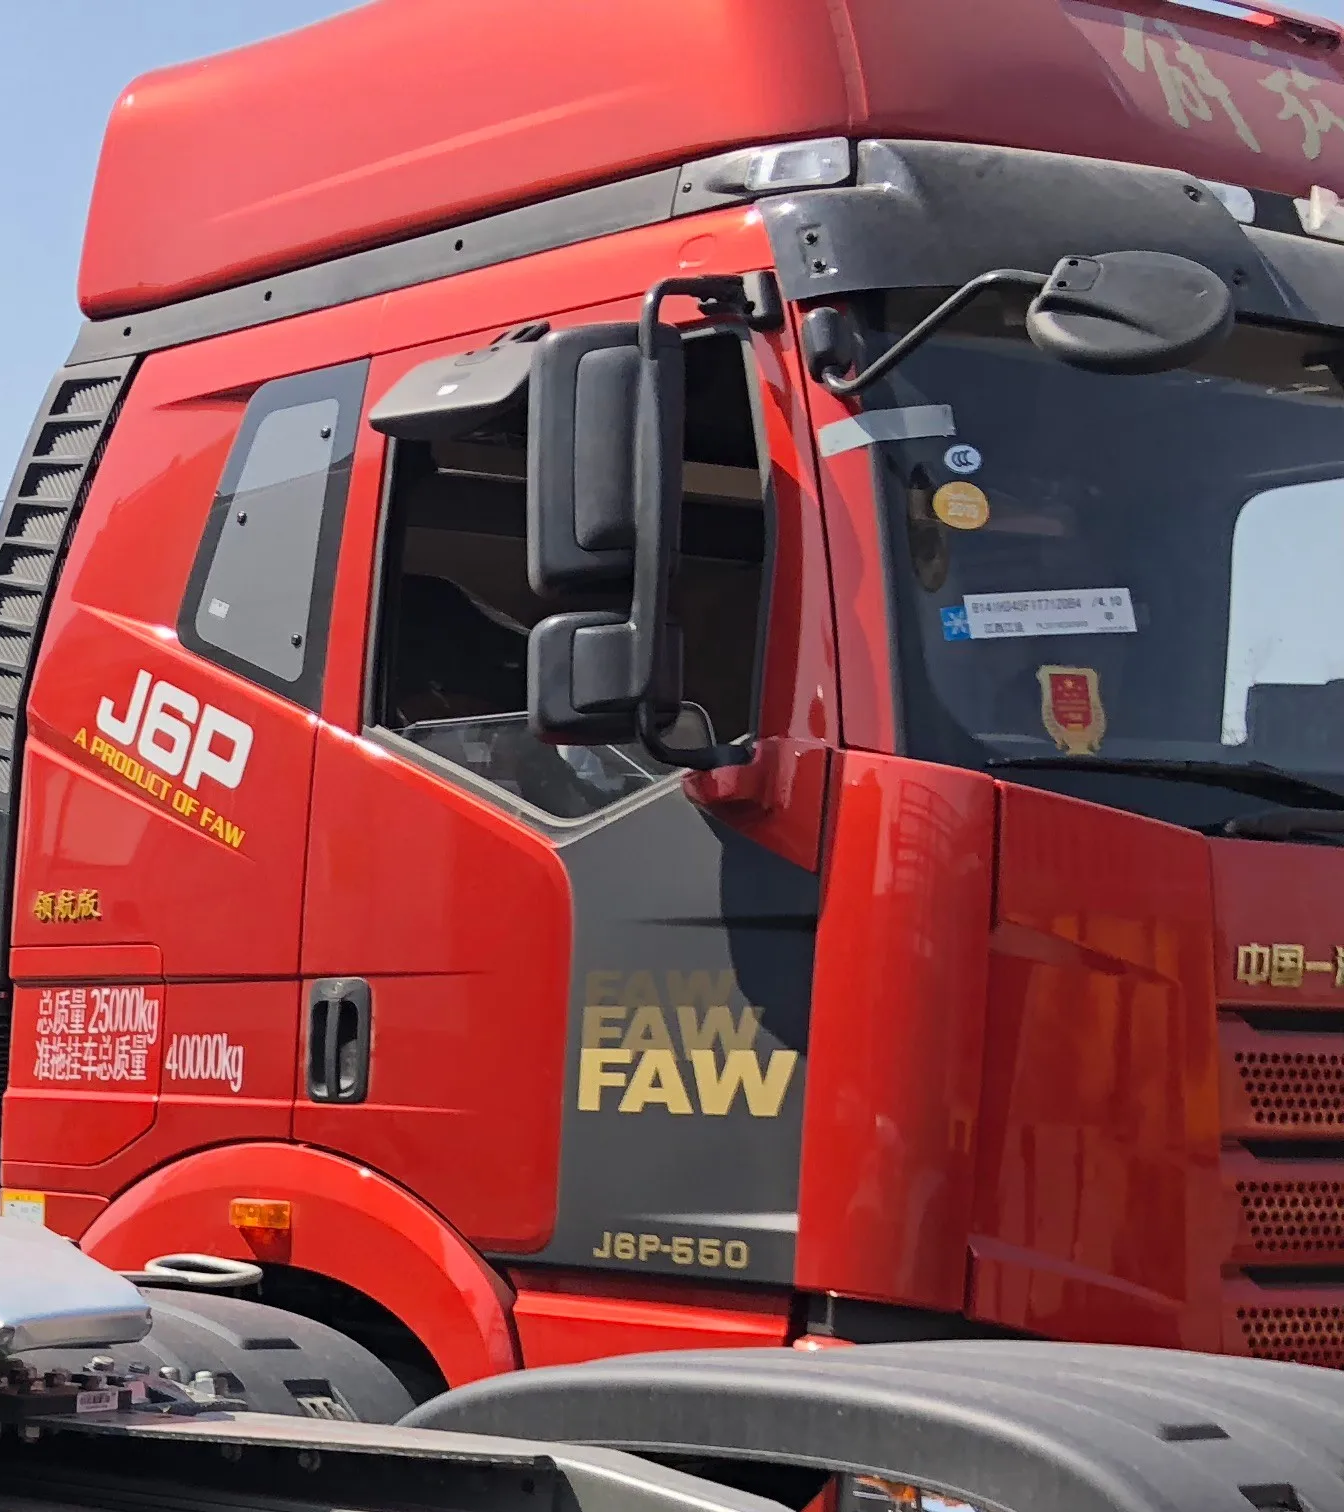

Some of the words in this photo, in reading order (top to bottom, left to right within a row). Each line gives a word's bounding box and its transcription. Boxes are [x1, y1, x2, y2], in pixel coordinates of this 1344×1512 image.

[96, 668, 254, 791] J6P
[73, 727, 88, 750] A
[89, 735, 172, 801] PRODUCT
[172, 789, 200, 817] OF
[199, 806, 246, 848] FAW
[33, 888, 102, 923] 领航版
[36, 988, 88, 1035] 总质量
[88, 986, 160, 1044] 25000kg
[33, 1034, 149, 1081] 准拖挂车总质量
[165, 1033, 244, 1093] 40000kg
[577, 1048, 799, 1117] FAW
[593, 1231, 749, 1269] J6P-550
